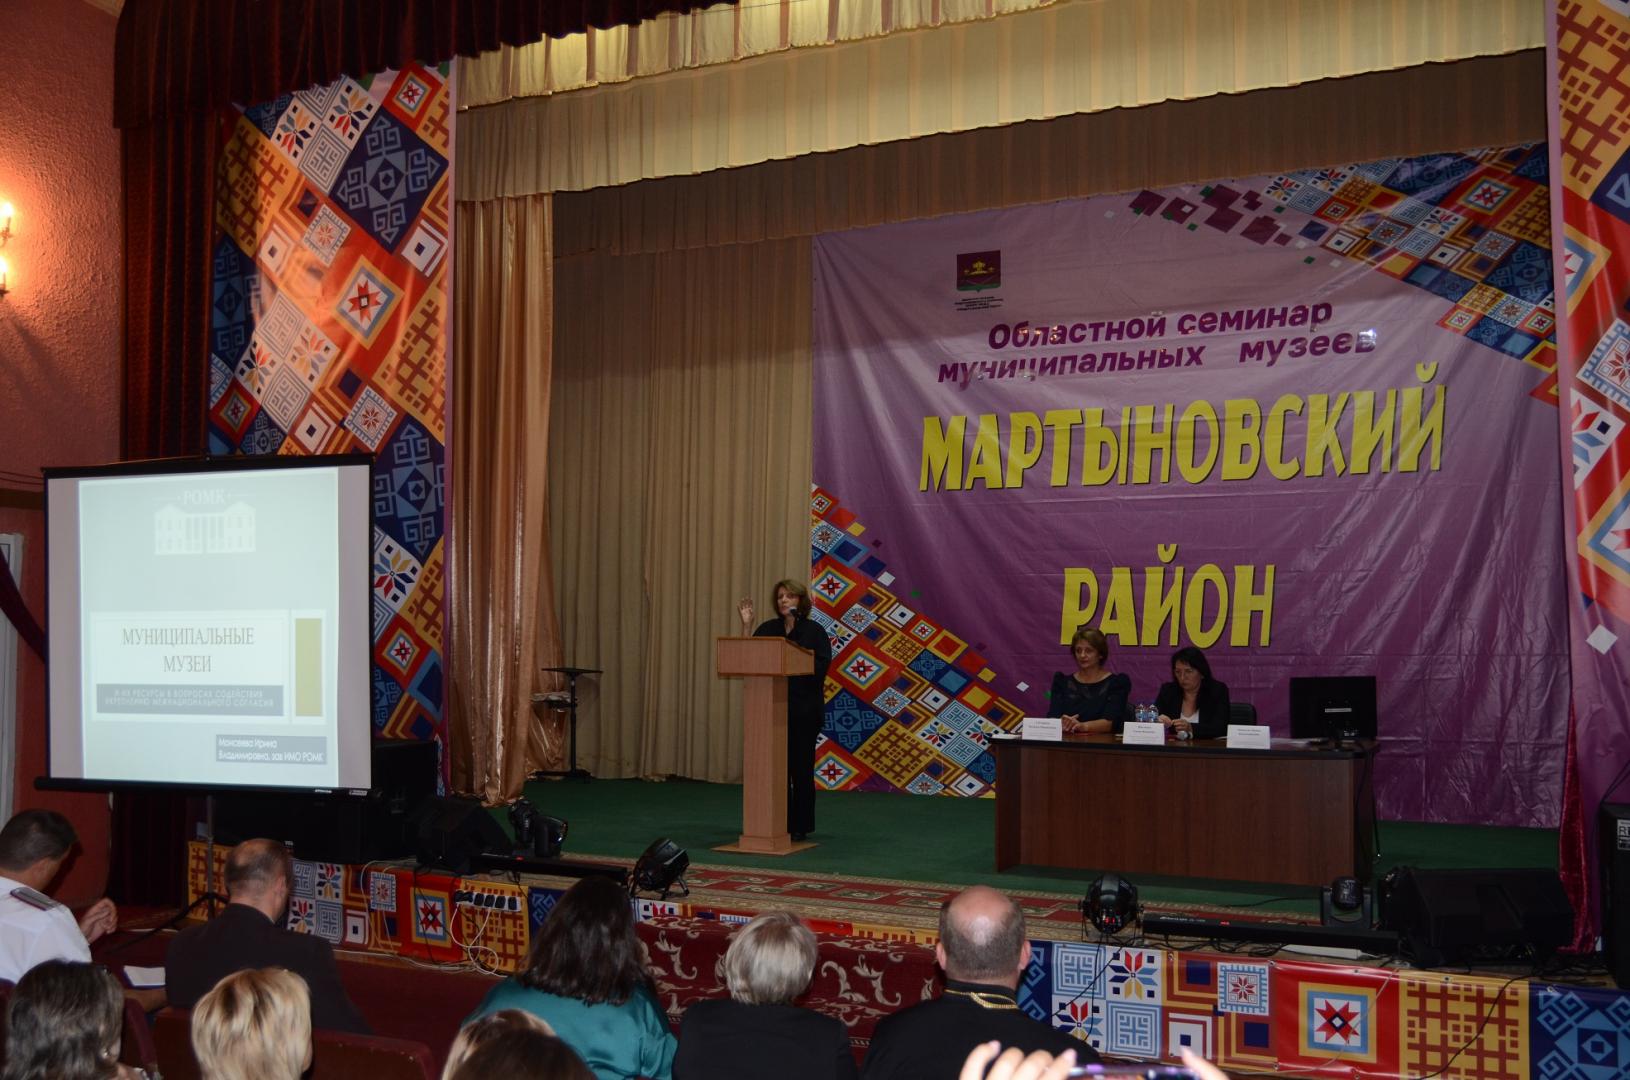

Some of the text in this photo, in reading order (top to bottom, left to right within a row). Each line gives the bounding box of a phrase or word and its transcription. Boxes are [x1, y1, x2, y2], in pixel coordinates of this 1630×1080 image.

[988, 302, 1333, 350] Областной семинар
[938, 328, 1377, 392] муниципальных музеев
[919, 361, 1447, 494] МАРТЫНОВСКИЙ
[1060, 543, 1276, 649] РАЙОН
[122, 627, 255, 647] МУНИЦИПАЛЬНЫЕ
[163, 655, 212, 672] МУЗЕИ
